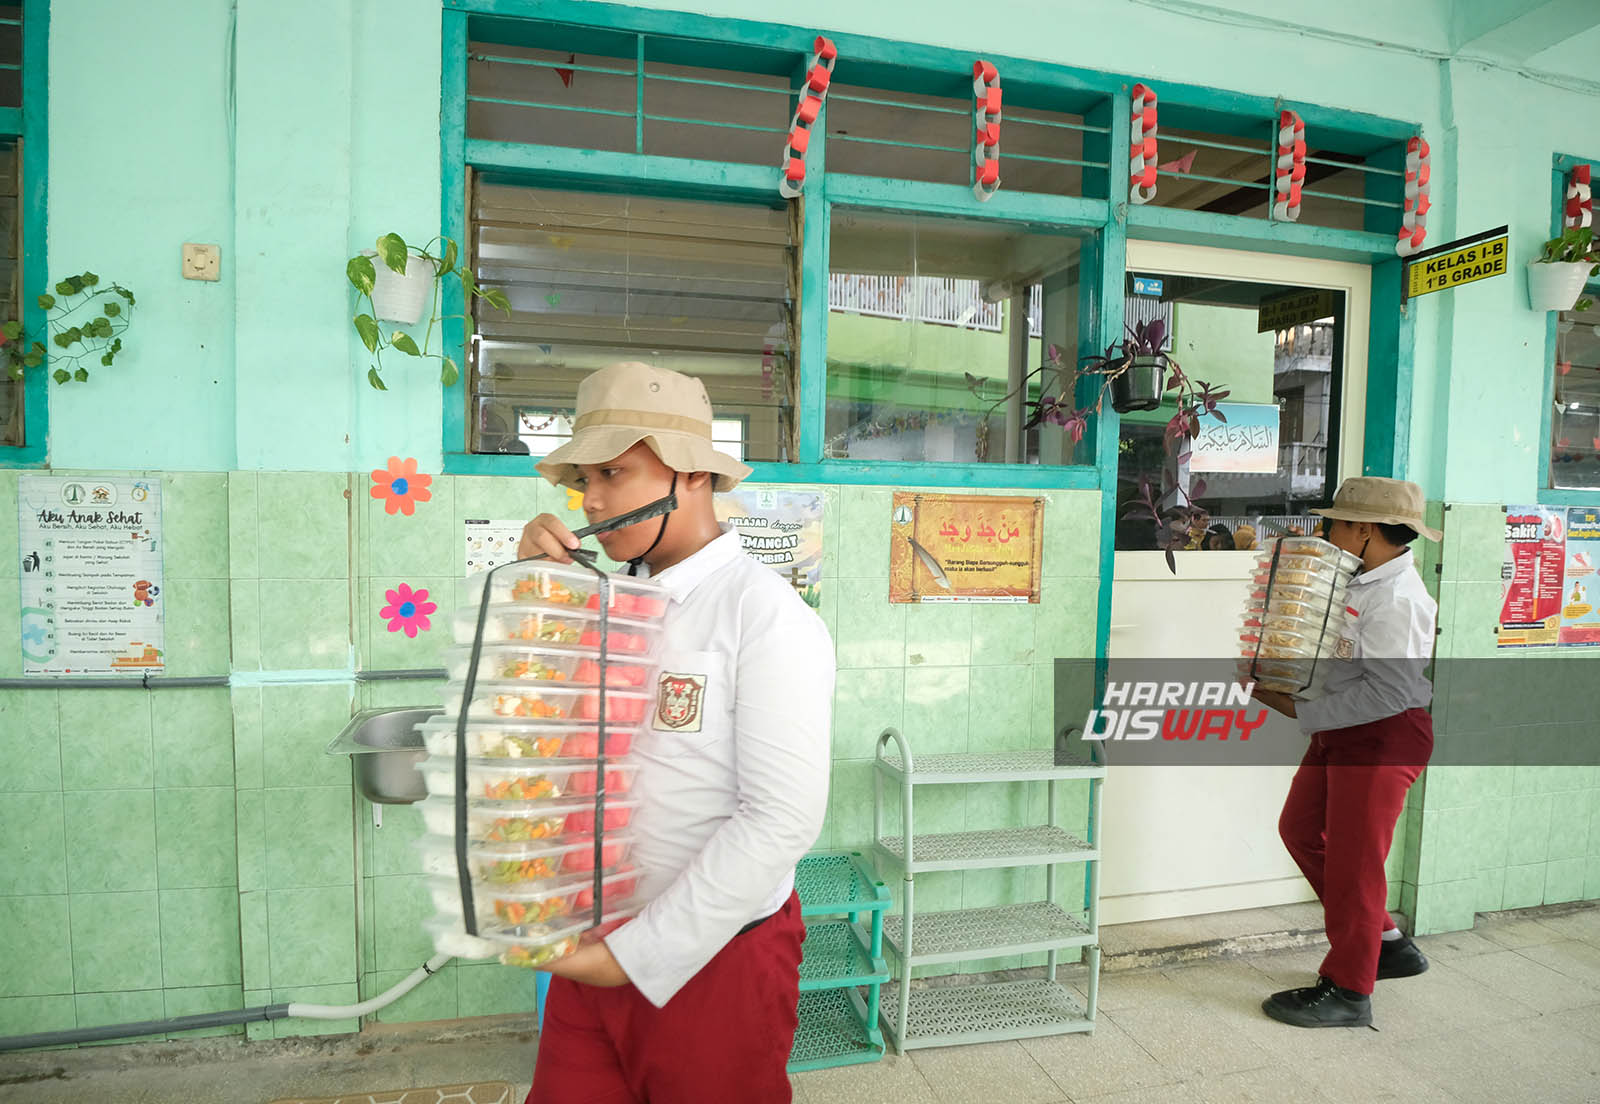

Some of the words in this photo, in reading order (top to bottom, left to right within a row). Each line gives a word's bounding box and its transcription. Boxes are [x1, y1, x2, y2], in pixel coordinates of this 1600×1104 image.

[1426, 250, 1476, 274] KELAS
[1482, 242, 1504, 259] I-B
[1438, 274, 1447, 286] B
[1452, 259, 1503, 282] GRADE
[37, 509, 64, 523] Aku
[67, 510, 103, 523] Anak
[106, 511, 143, 524] Sehat
[728, 517, 768, 527] BELAJAR
[771, 519, 803, 533] dengan
[1505, 524, 1536, 538] Sakit
[739, 534, 798, 550] EMANGAT
